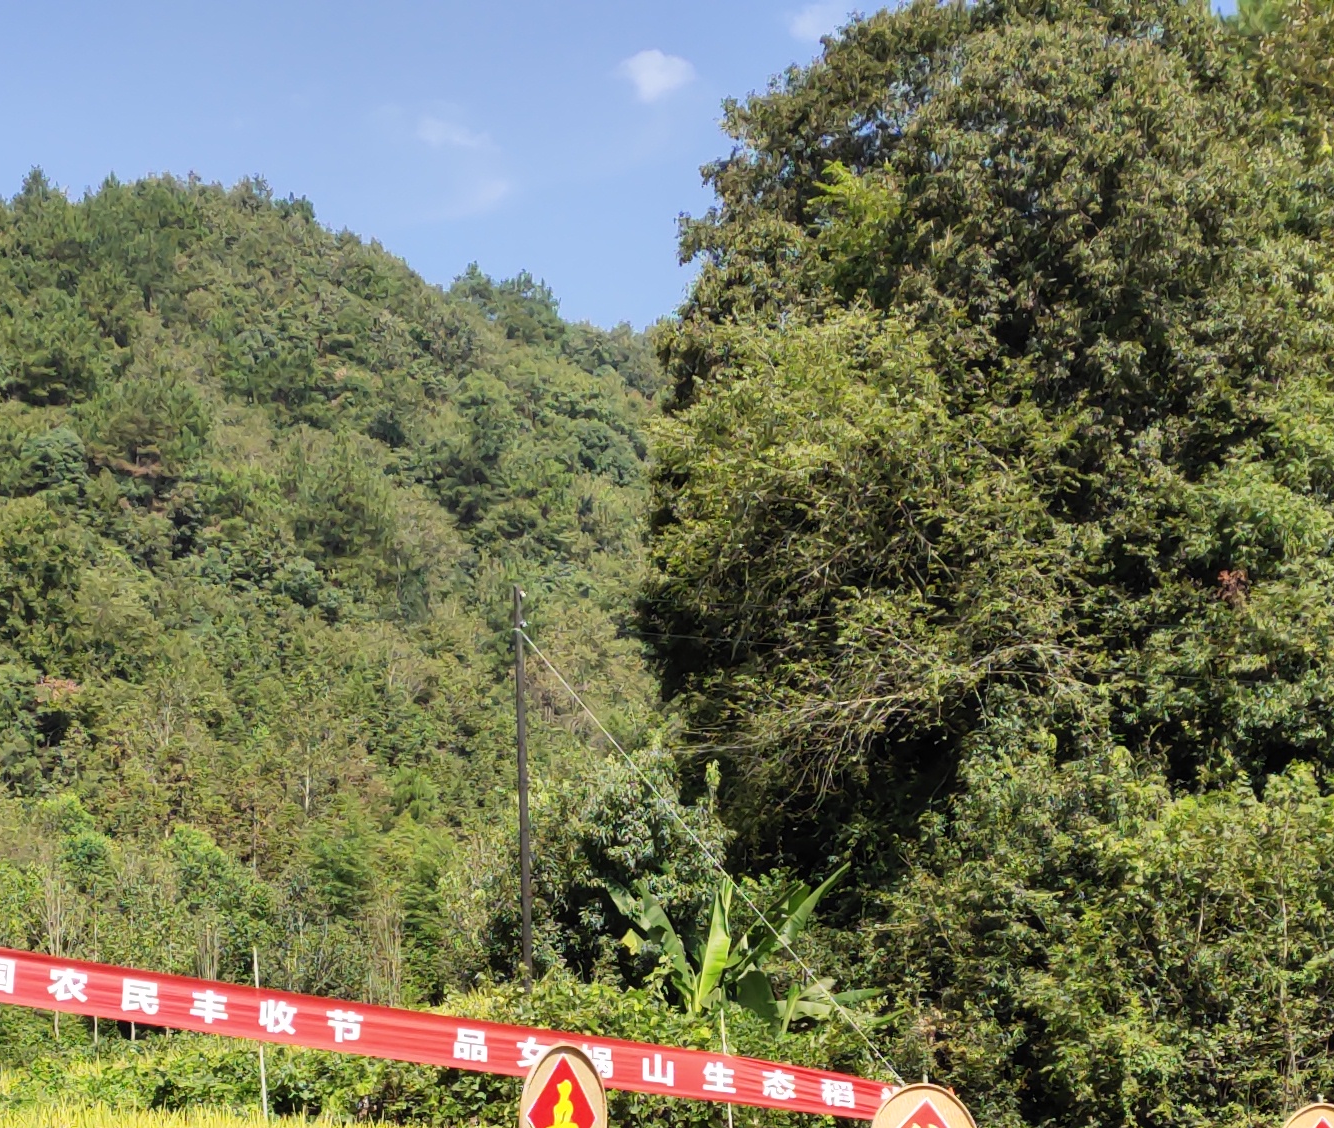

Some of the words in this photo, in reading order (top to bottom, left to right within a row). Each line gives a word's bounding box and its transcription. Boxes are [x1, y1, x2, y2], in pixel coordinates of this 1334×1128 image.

[452, 1026, 902, 1109] 品女娲山生态稻
